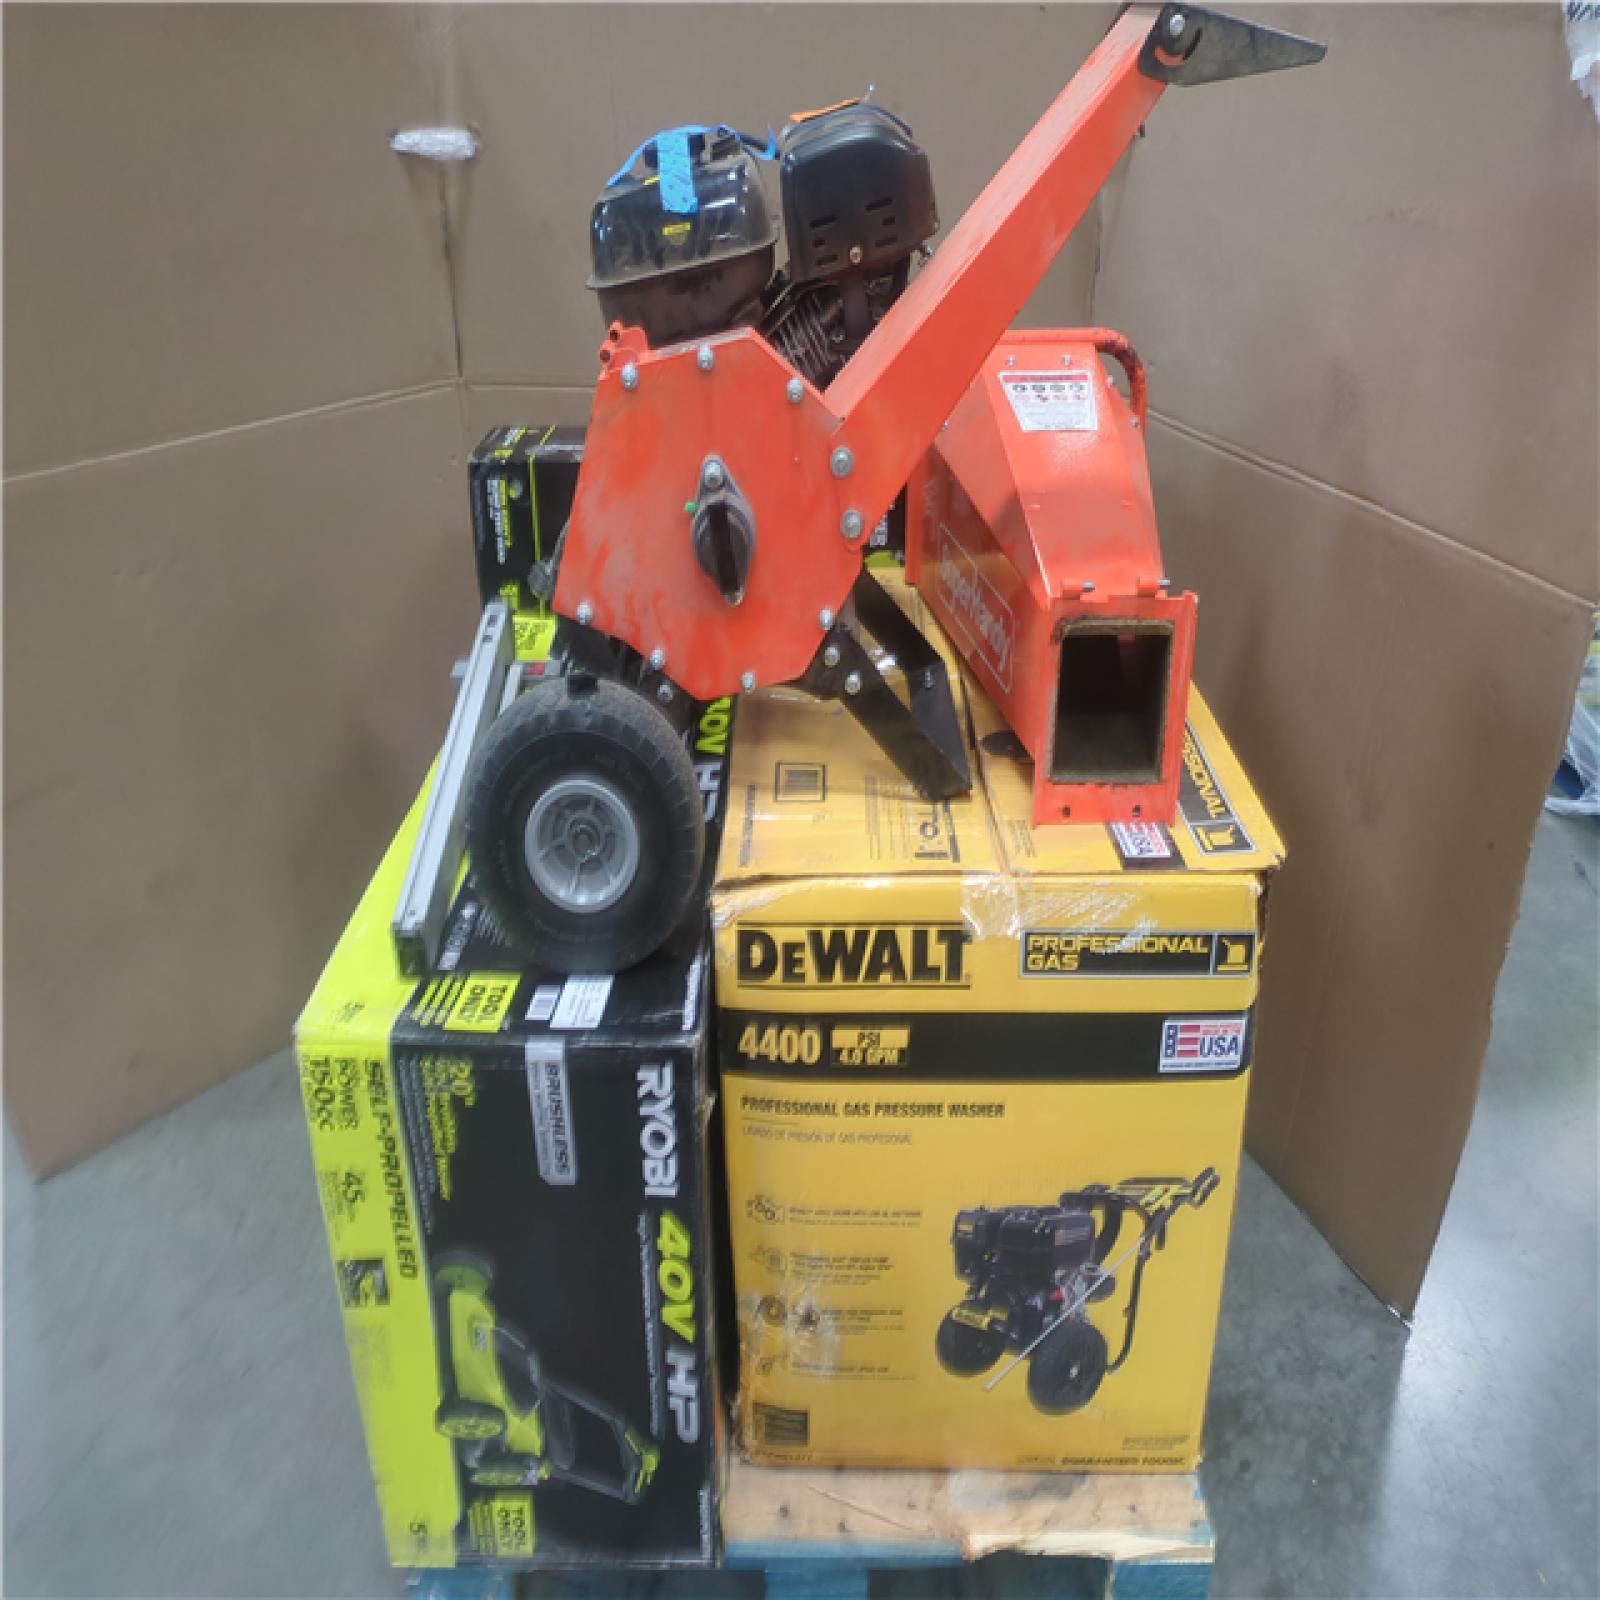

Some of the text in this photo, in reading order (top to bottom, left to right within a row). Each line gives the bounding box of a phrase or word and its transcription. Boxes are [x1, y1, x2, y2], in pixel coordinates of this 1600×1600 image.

[1026, 954, 1080, 971] GAS
[1027, 934, 1209, 955] PROFESSIONAL
[457, 983, 486, 1022] ONLY
[480, 983, 509, 1021] TOOL
[737, 1023, 822, 1066] 4400
[857, 1031, 881, 1048] PSI
[866, 1048, 899, 1066] GPM
[1199, 1034, 1240, 1058] USA
[543, 1063, 571, 1176] BRUSHLESS
[740, 1096, 1006, 1119] PROFESSIONAL GAS PRESSURE WASHER
[343, 1170, 365, 1204] 45
[363, 1058, 419, 1280] SELF-PROPELLED
[634, 1059, 700, 1444] RYOBI 40V HP
[511, 1507, 527, 1551] TOOL
